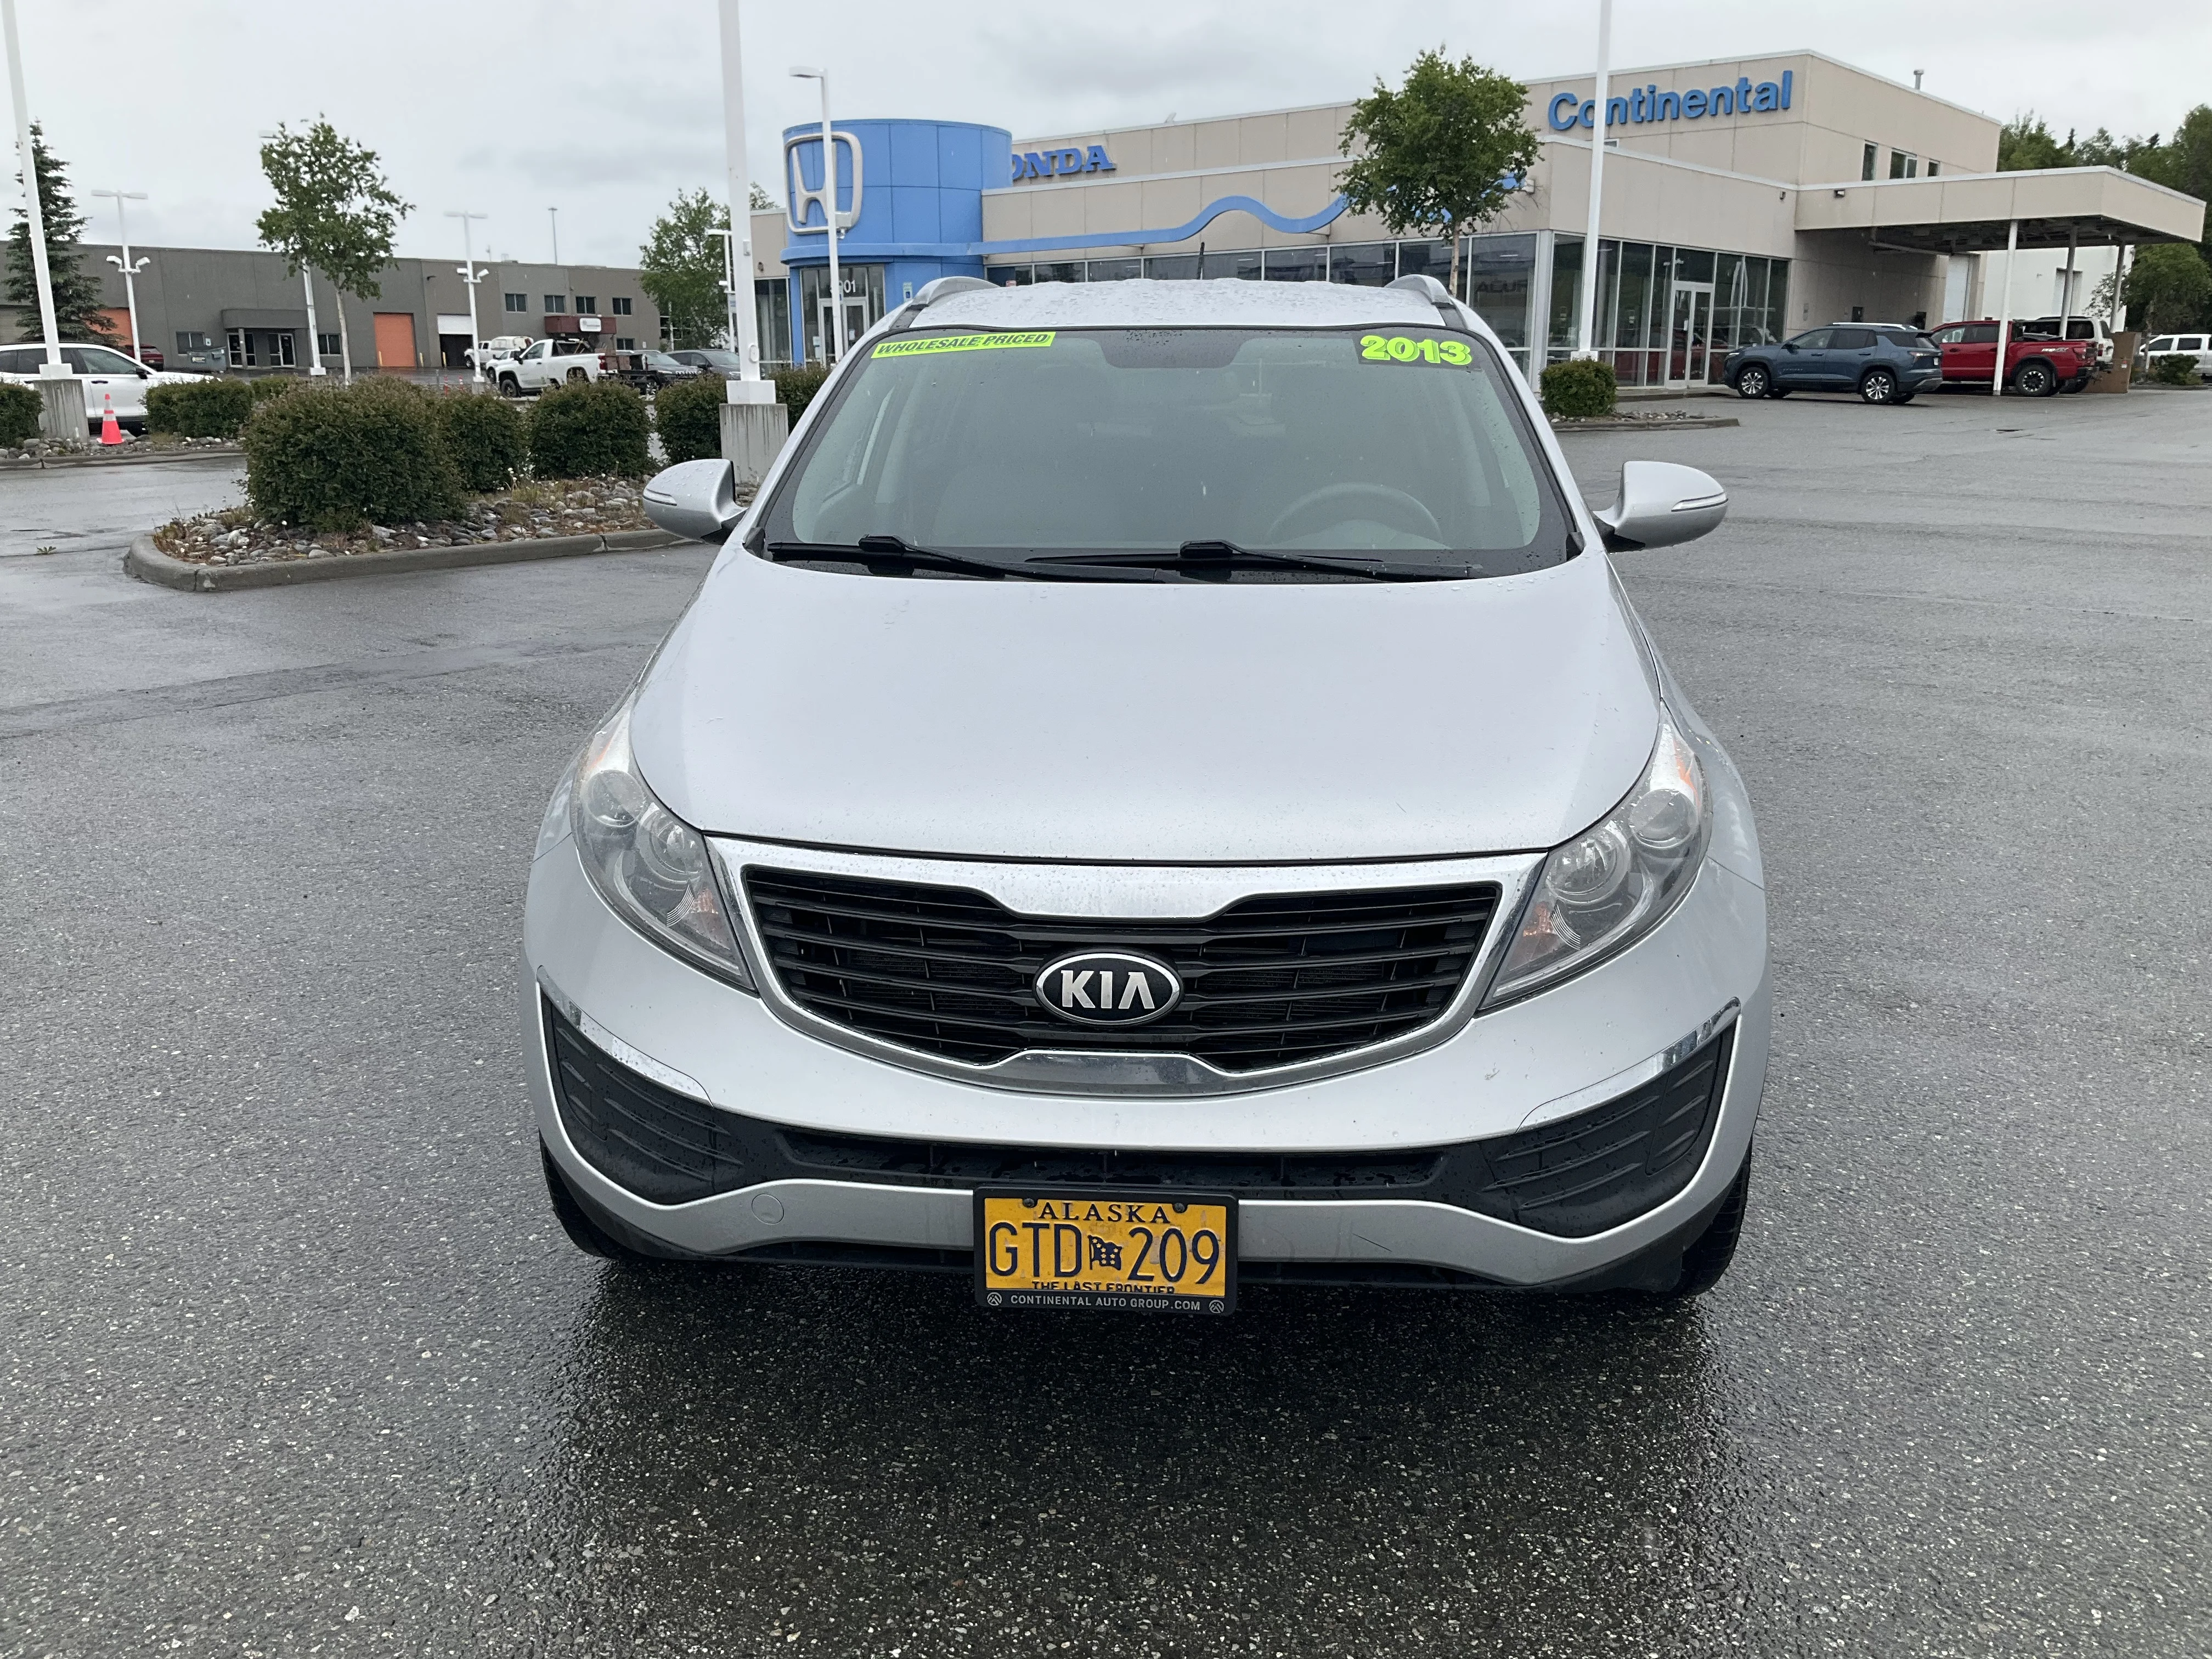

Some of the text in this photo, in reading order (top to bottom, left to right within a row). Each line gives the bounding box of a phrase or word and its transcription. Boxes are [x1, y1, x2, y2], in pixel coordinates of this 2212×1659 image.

[1548, 70, 1793, 131] Continental
[877, 334, 1051, 354] WHOLESALE PRICED
[1360, 335, 1472, 365] 2013
[1060, 969, 1155, 1009] KIA
[1038, 1201, 1171, 1224] ALASKA
[989, 1222, 1220, 1284] GTD 209
[1032, 1281, 1175, 1294] THE LAST FRONTIER
[1011, 1295, 1092, 1306] CONTINENTAL
[1095, 1296, 1126, 1307] AUTO
